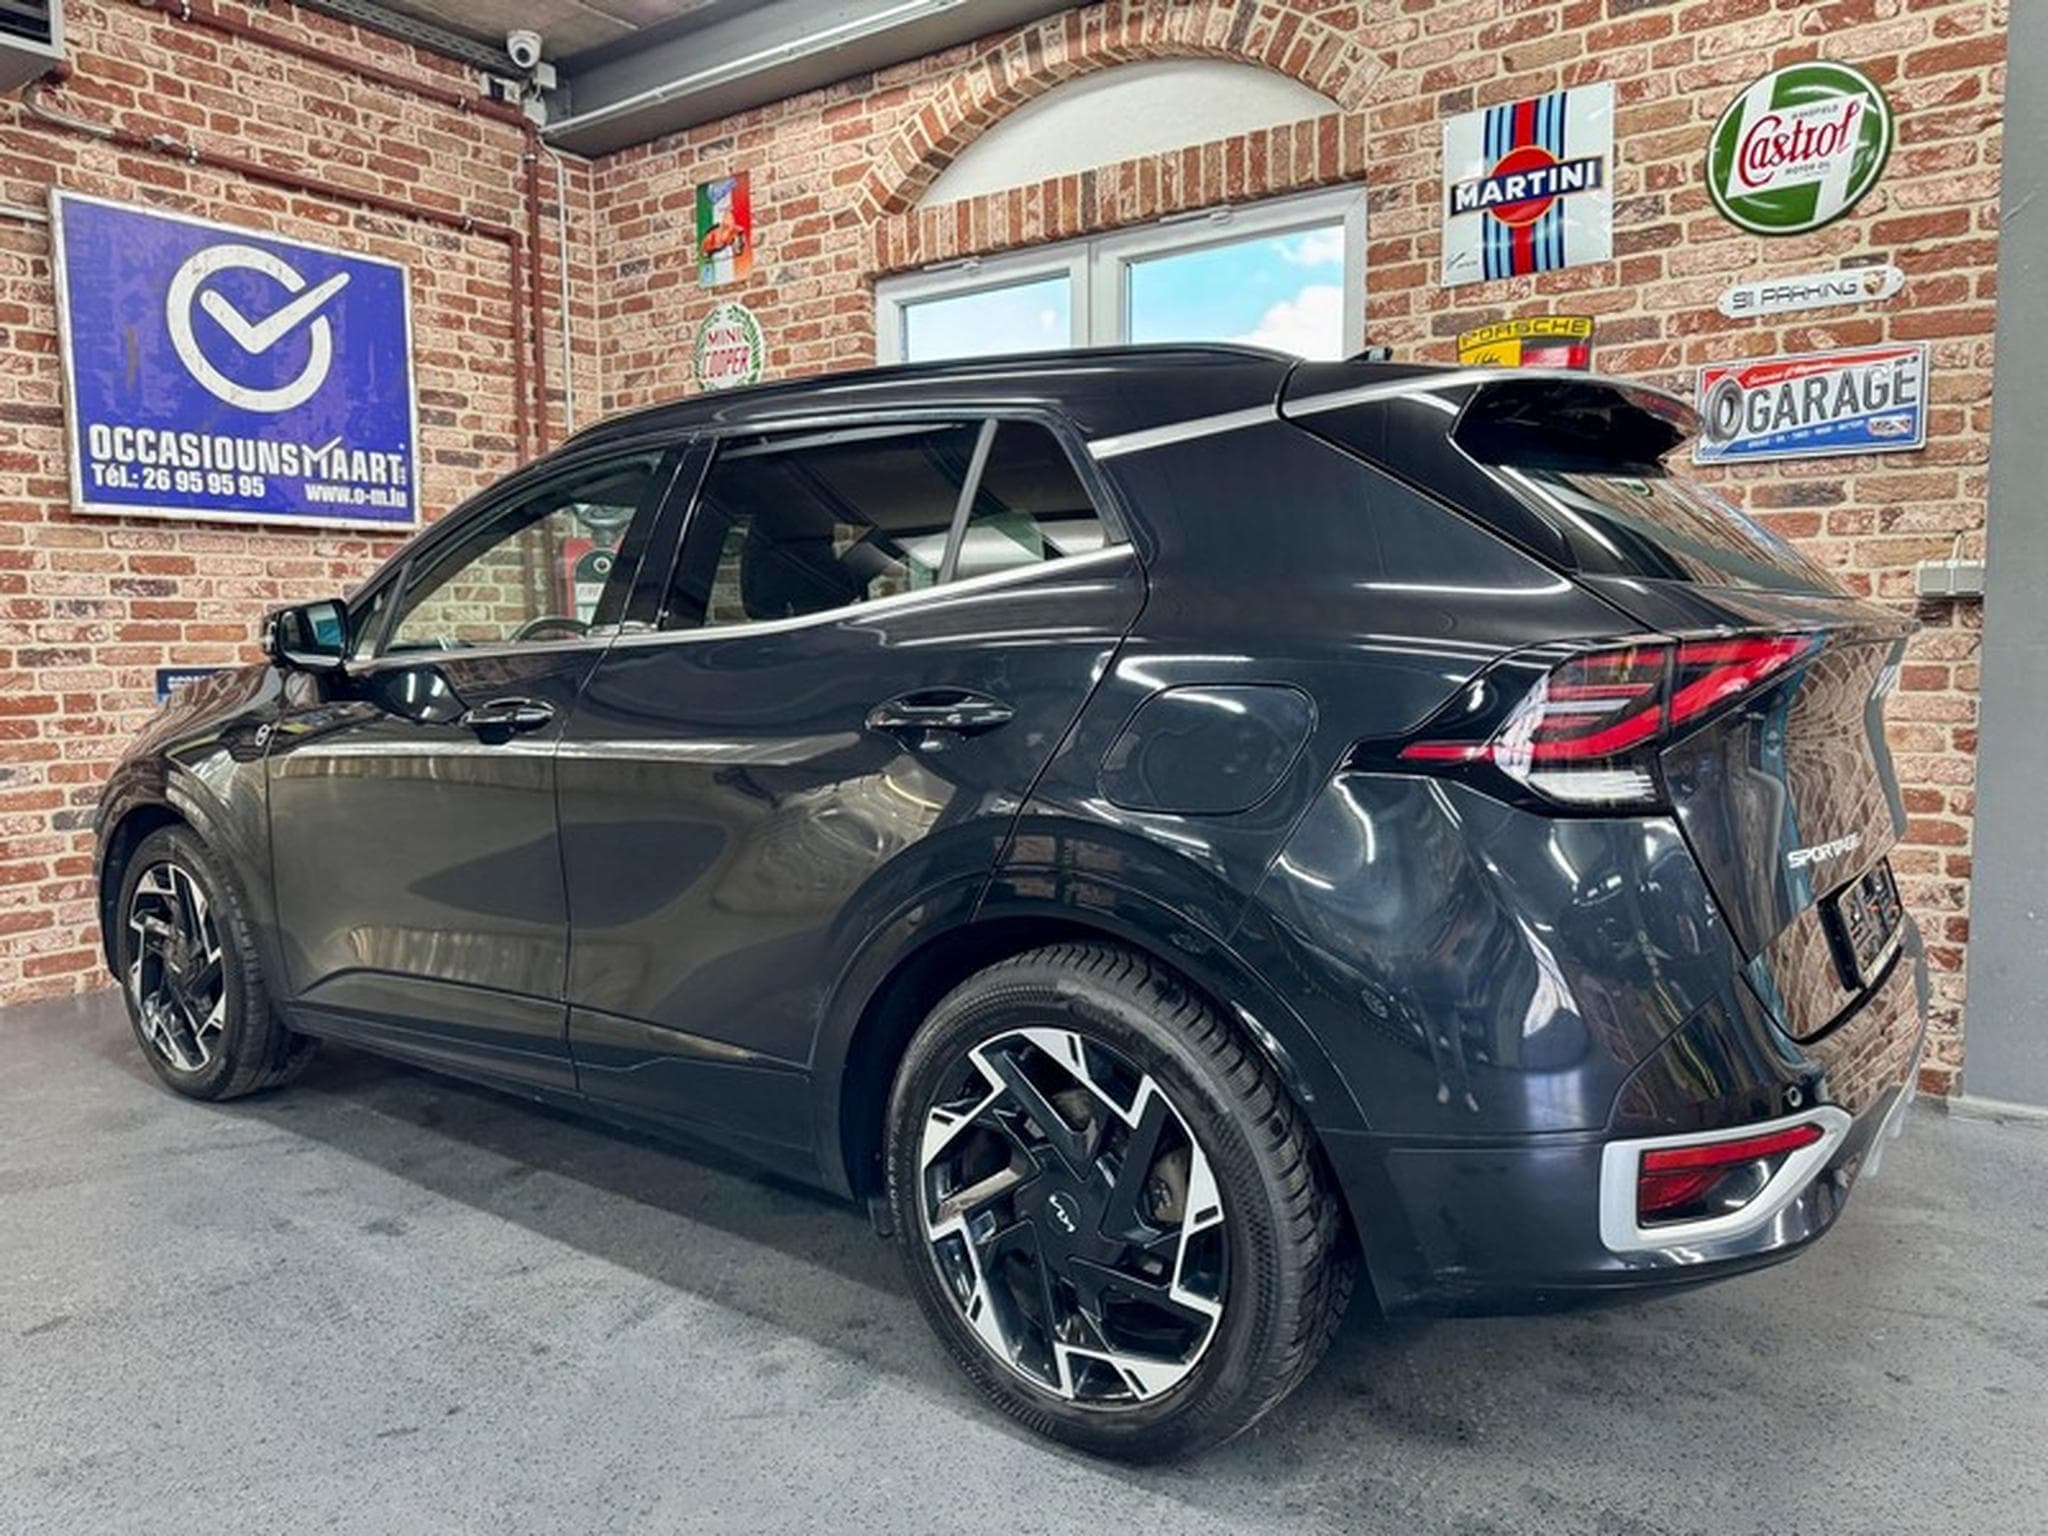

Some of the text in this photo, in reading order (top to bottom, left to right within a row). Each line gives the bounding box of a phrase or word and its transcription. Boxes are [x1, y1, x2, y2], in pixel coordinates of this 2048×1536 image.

[1739, 99, 1860, 188] Castrol
[1455, 161, 1596, 212] MARTINI
[1760, 281, 1857, 305] PARKING
[1461, 320, 1585, 347] PORSCHE
[1746, 354, 1917, 434] GARAGE
[143, 467, 171, 492] 26
[175, 469, 203, 494] 95
[207, 472, 235, 496] 95
[238, 475, 266, 499] 95
[304, 483, 407, 508] www.o-m.lu
